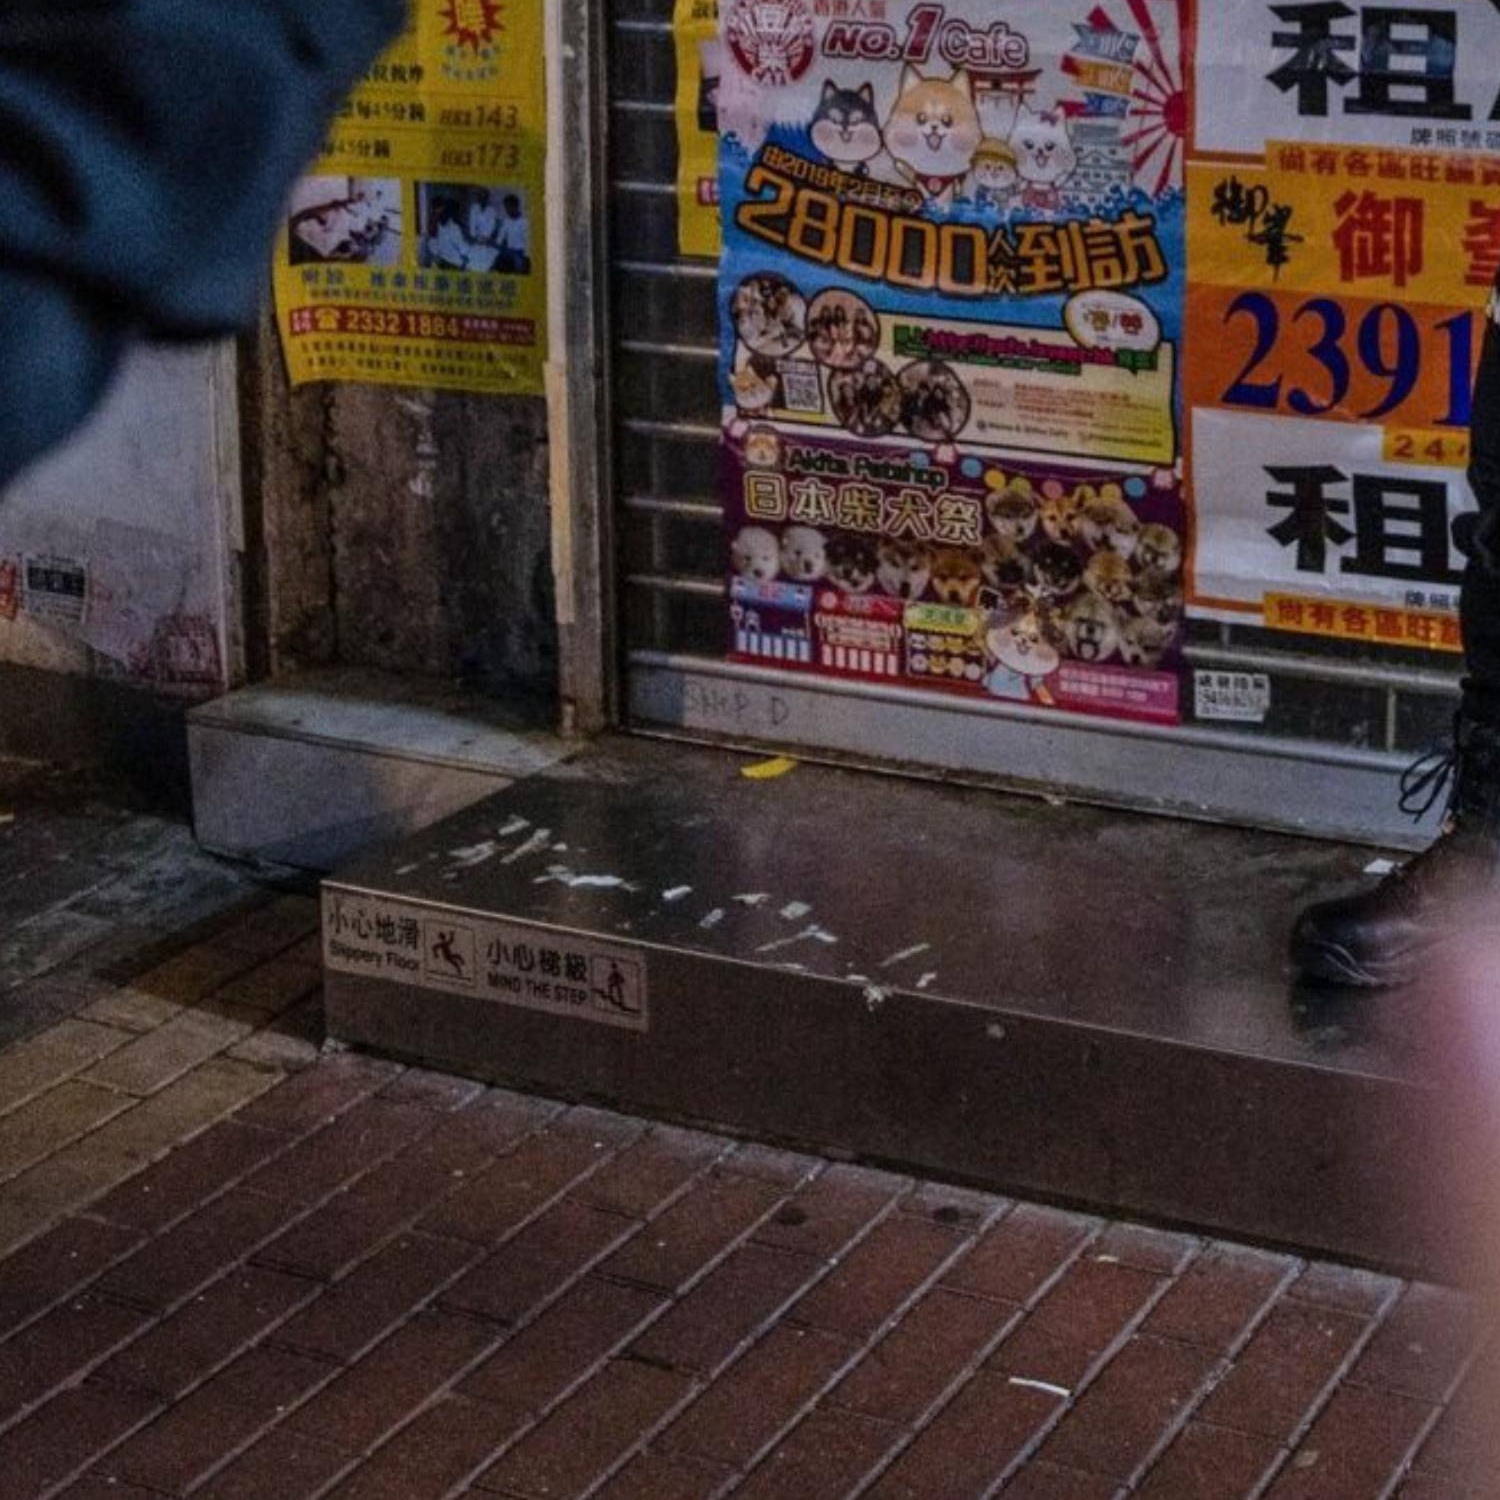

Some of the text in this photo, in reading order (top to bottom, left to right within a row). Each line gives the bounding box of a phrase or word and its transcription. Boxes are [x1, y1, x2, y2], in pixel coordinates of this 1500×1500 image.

[823, 2, 943, 63] NO.1
[938, 20, 1030, 69] Cafe
[1392, 434, 1467, 461] 24
[743, 471, 983, 545] 日本柴犬祭
[1262, 463, 1466, 584] 租
[328, 903, 420, 951] 小心地滑
[486, 972, 588, 1003] MIND THE STEP
